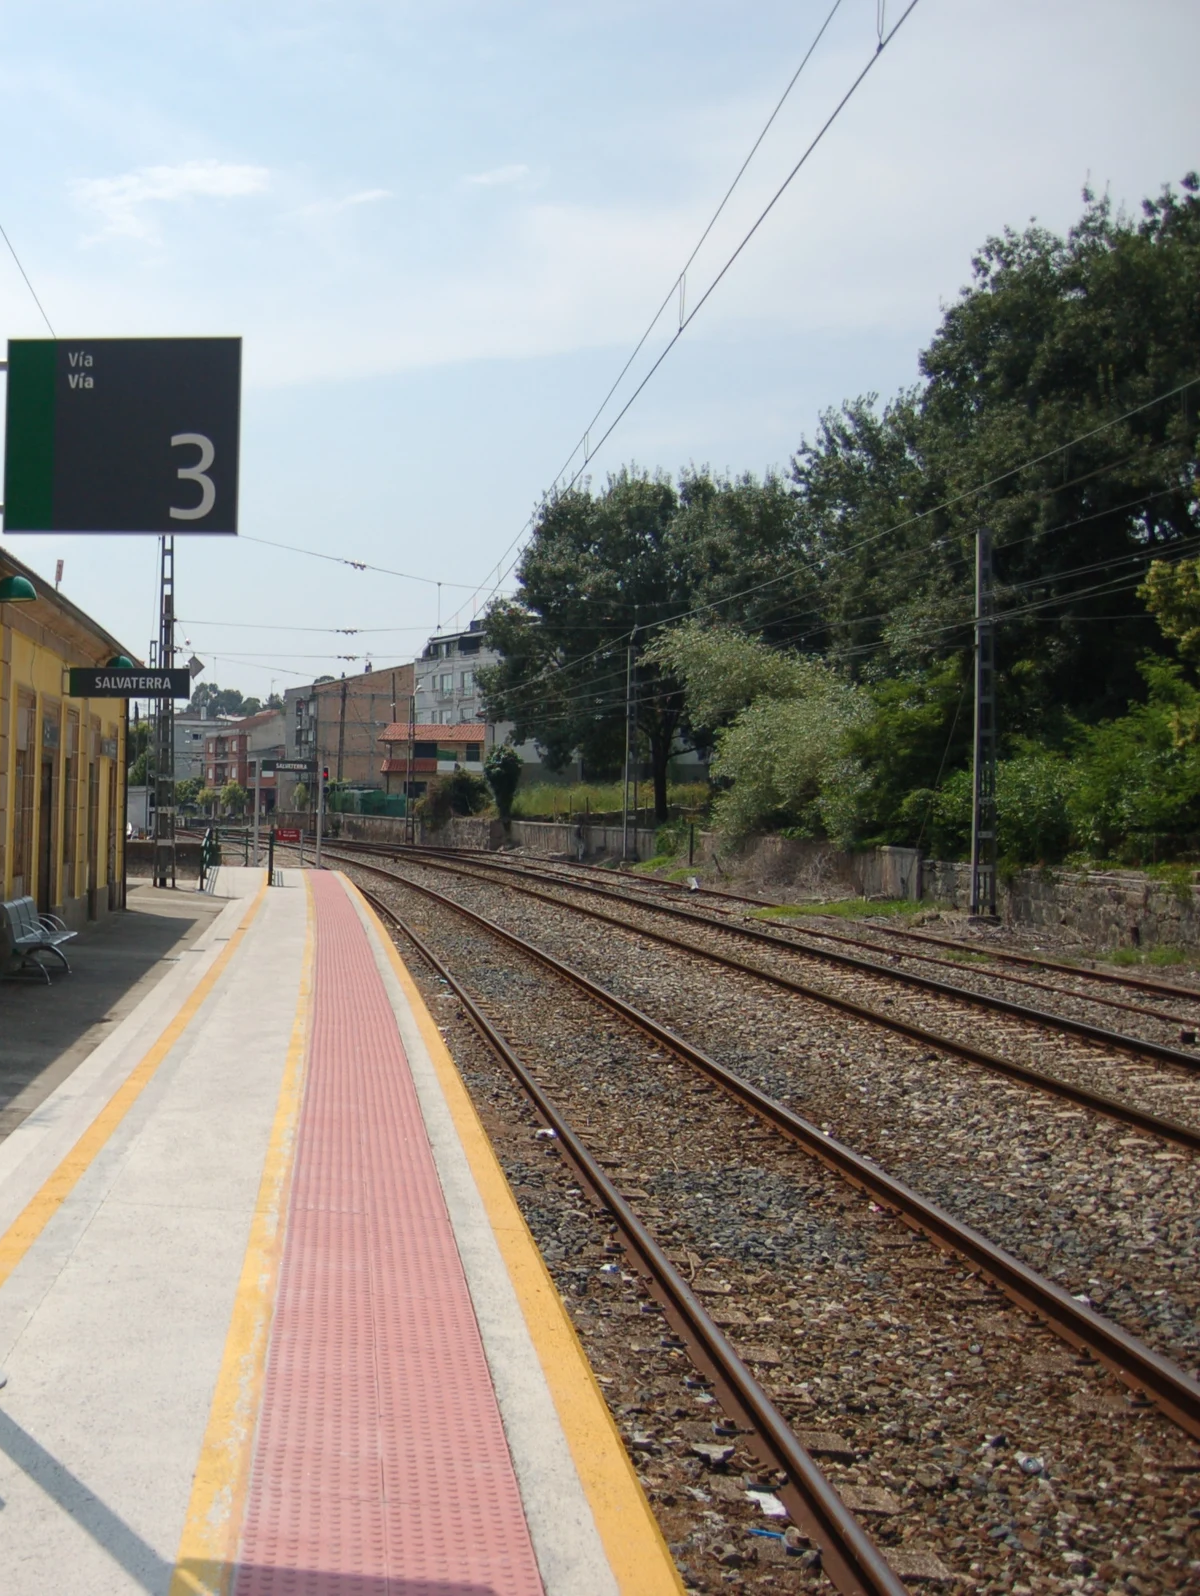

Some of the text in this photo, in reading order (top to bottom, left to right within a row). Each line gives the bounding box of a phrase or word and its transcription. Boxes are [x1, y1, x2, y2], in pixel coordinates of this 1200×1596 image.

[68, 351, 93, 367] Vía
[68, 372, 94, 389] Vía
[169, 433, 216, 520] 3
[95, 676, 172, 690] SALVATERRA
